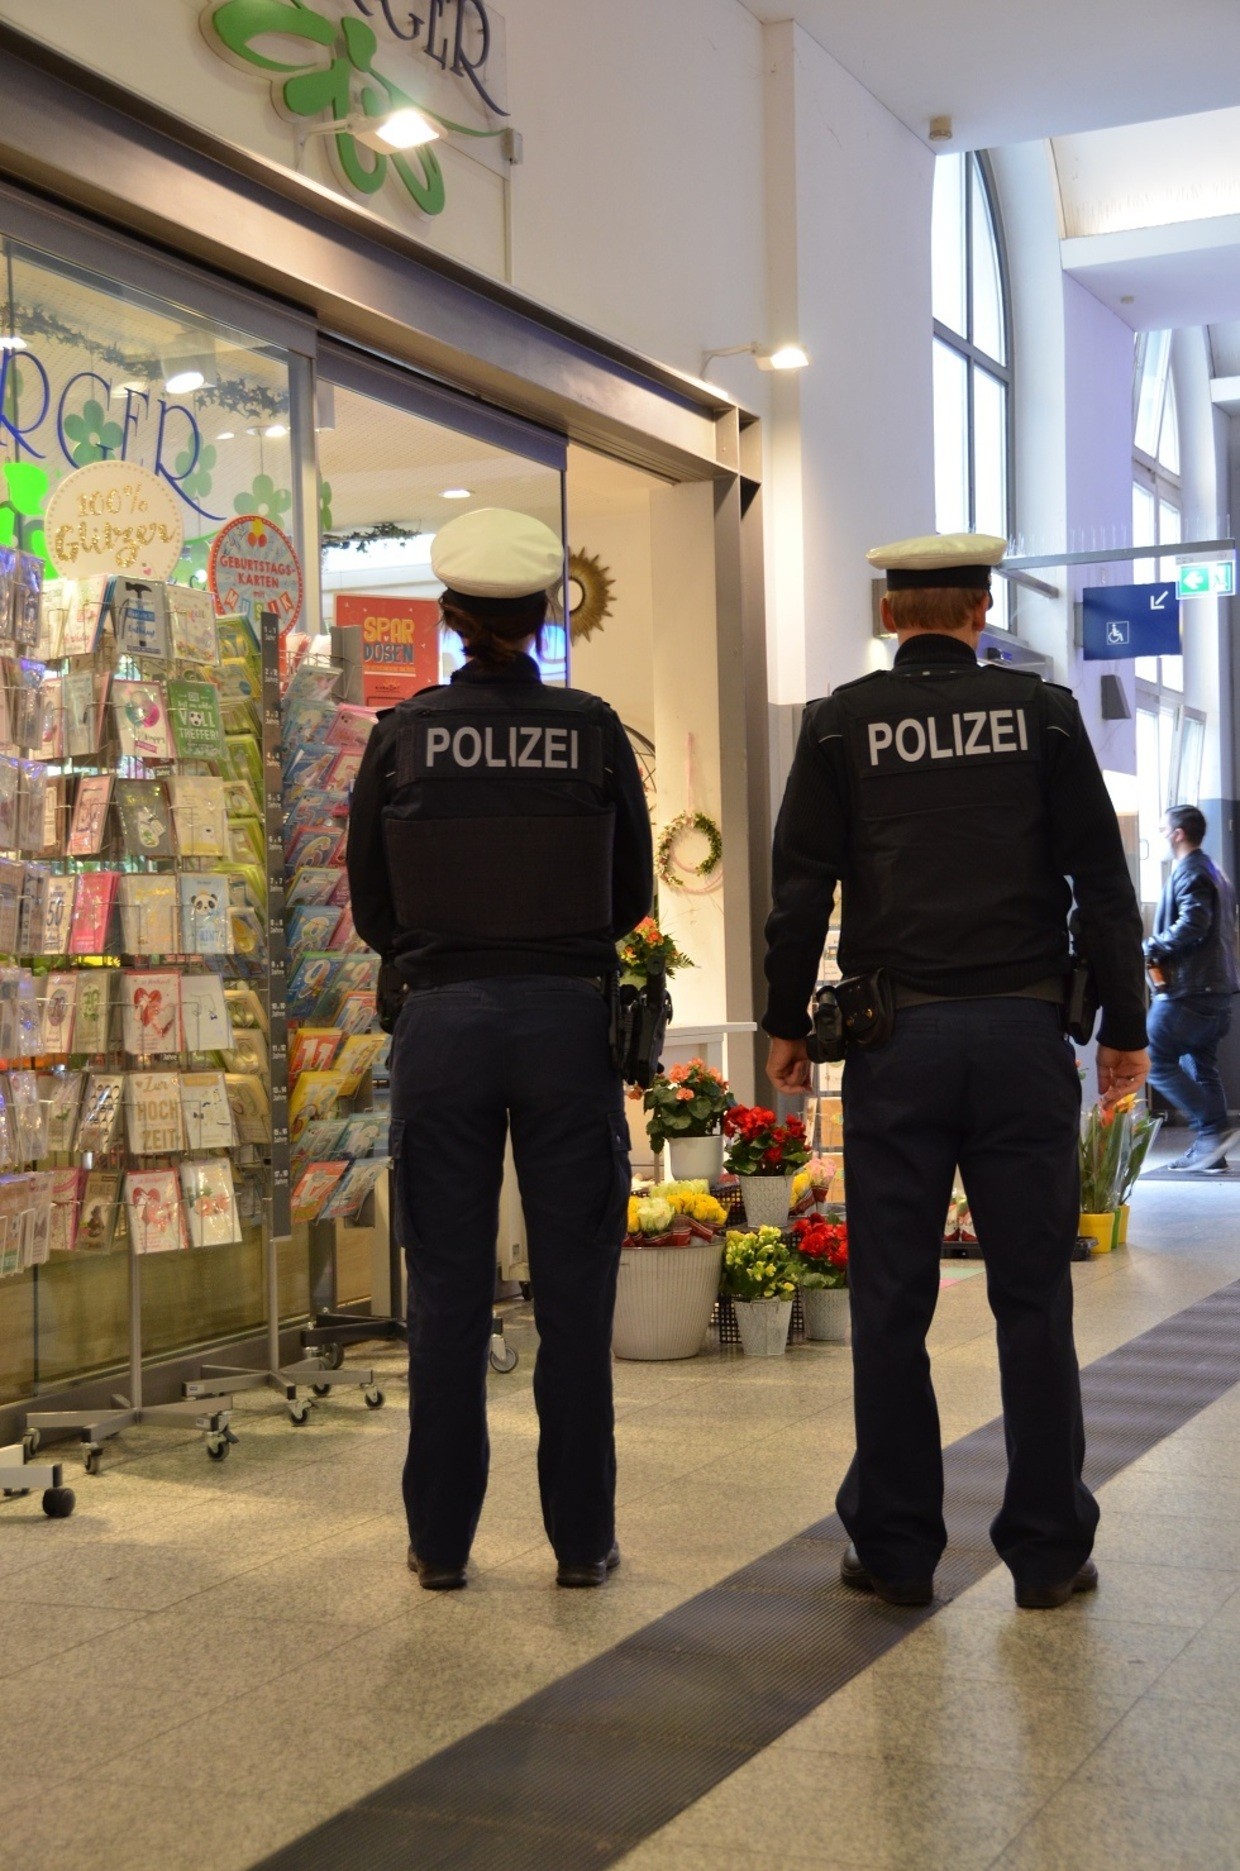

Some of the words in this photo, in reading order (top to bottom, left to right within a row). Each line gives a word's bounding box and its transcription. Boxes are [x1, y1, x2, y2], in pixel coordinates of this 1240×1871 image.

[77, 483, 148, 517] 100%
[54, 521, 179, 568] Glitzer
[219, 555, 297, 576] GEBURTSTAGS-
[237, 573, 280, 589] KARTEN
[364, 616, 415, 643] SPAR
[364, 642, 414, 663] DOSEN
[427, 727, 579, 769] POLIZEI
[867, 709, 1029, 766] POLIZEI
[300, 1038, 335, 1072] 11
[137, 1099, 179, 1122] HOCH
[142, 1127, 177, 1151] ZEIT
